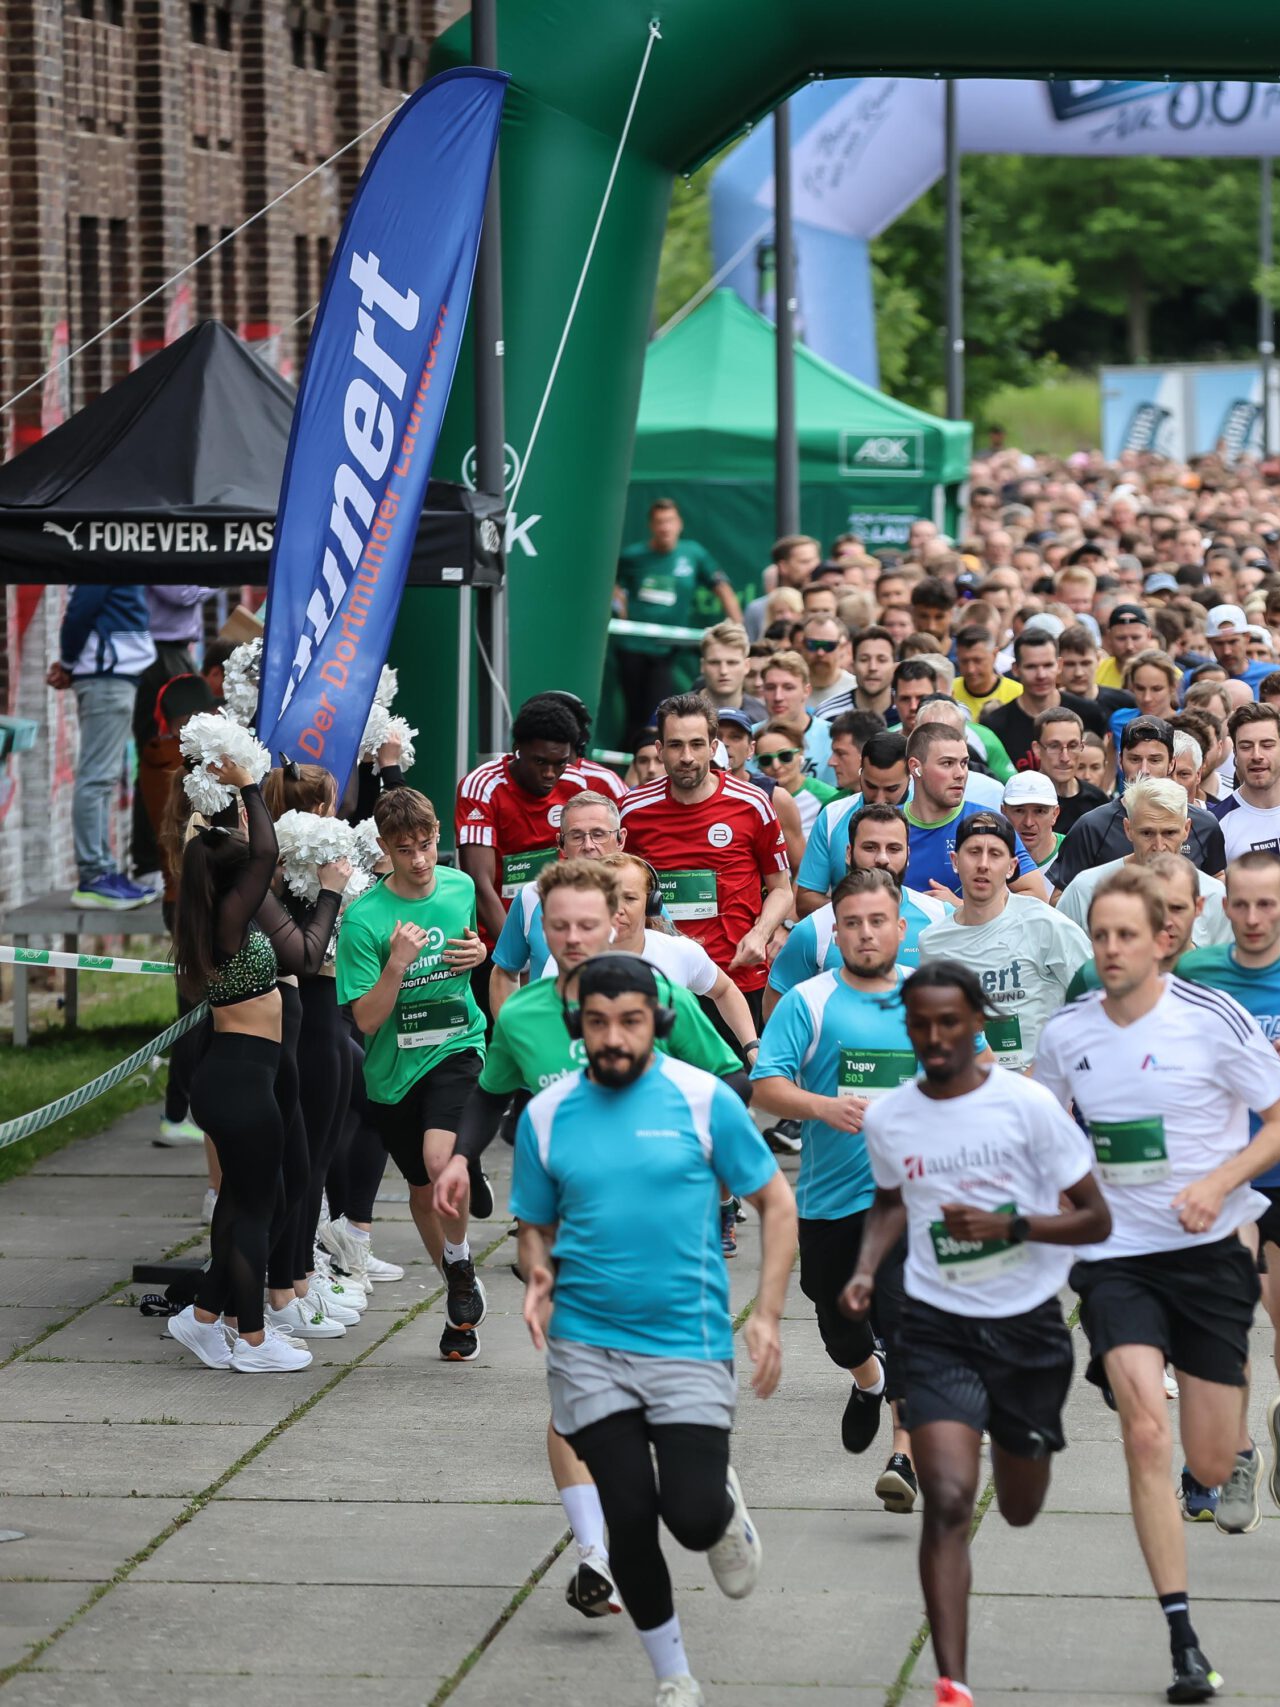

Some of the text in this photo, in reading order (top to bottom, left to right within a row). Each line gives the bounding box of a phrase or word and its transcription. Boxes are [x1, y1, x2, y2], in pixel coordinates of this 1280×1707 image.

[854, 437, 910, 463] AOK
[278, 250, 420, 721] unert
[89, 521, 276, 553] FOREVER. FAS
[298, 691, 338, 759] Der
[507, 862, 531, 872] Cedric
[402, 1010, 428, 1021] Lasse
[402, 1021, 419, 1031] 171
[846, 1060, 876, 1072] Tugay
[845, 1073, 864, 1084] 503
